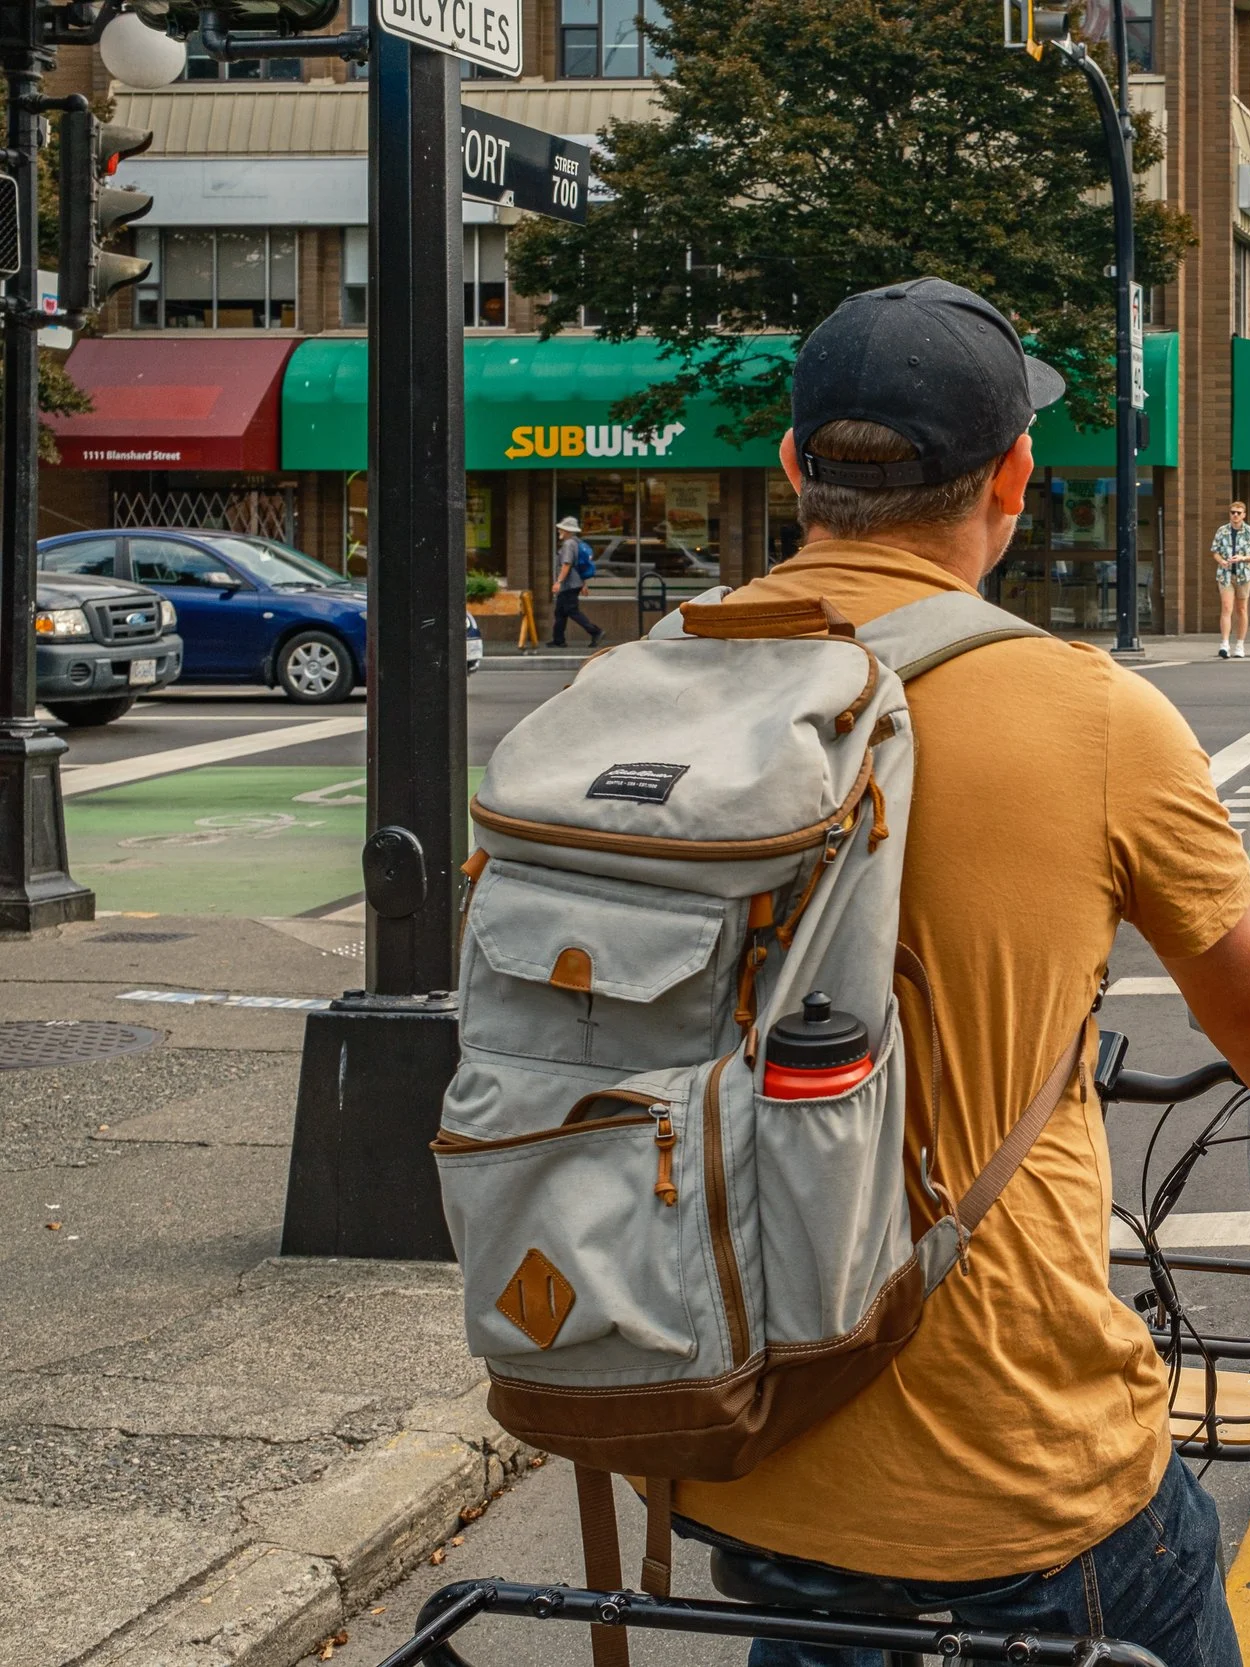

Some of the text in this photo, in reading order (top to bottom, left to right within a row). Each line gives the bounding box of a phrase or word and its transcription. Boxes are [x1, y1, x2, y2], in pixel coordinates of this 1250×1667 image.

[554, 156, 579, 176] STREET
[552, 175, 578, 209] 700
[505, 421, 686, 460] SUBWAY
[83, 449, 181, 460] 1111 Blanshard Street
